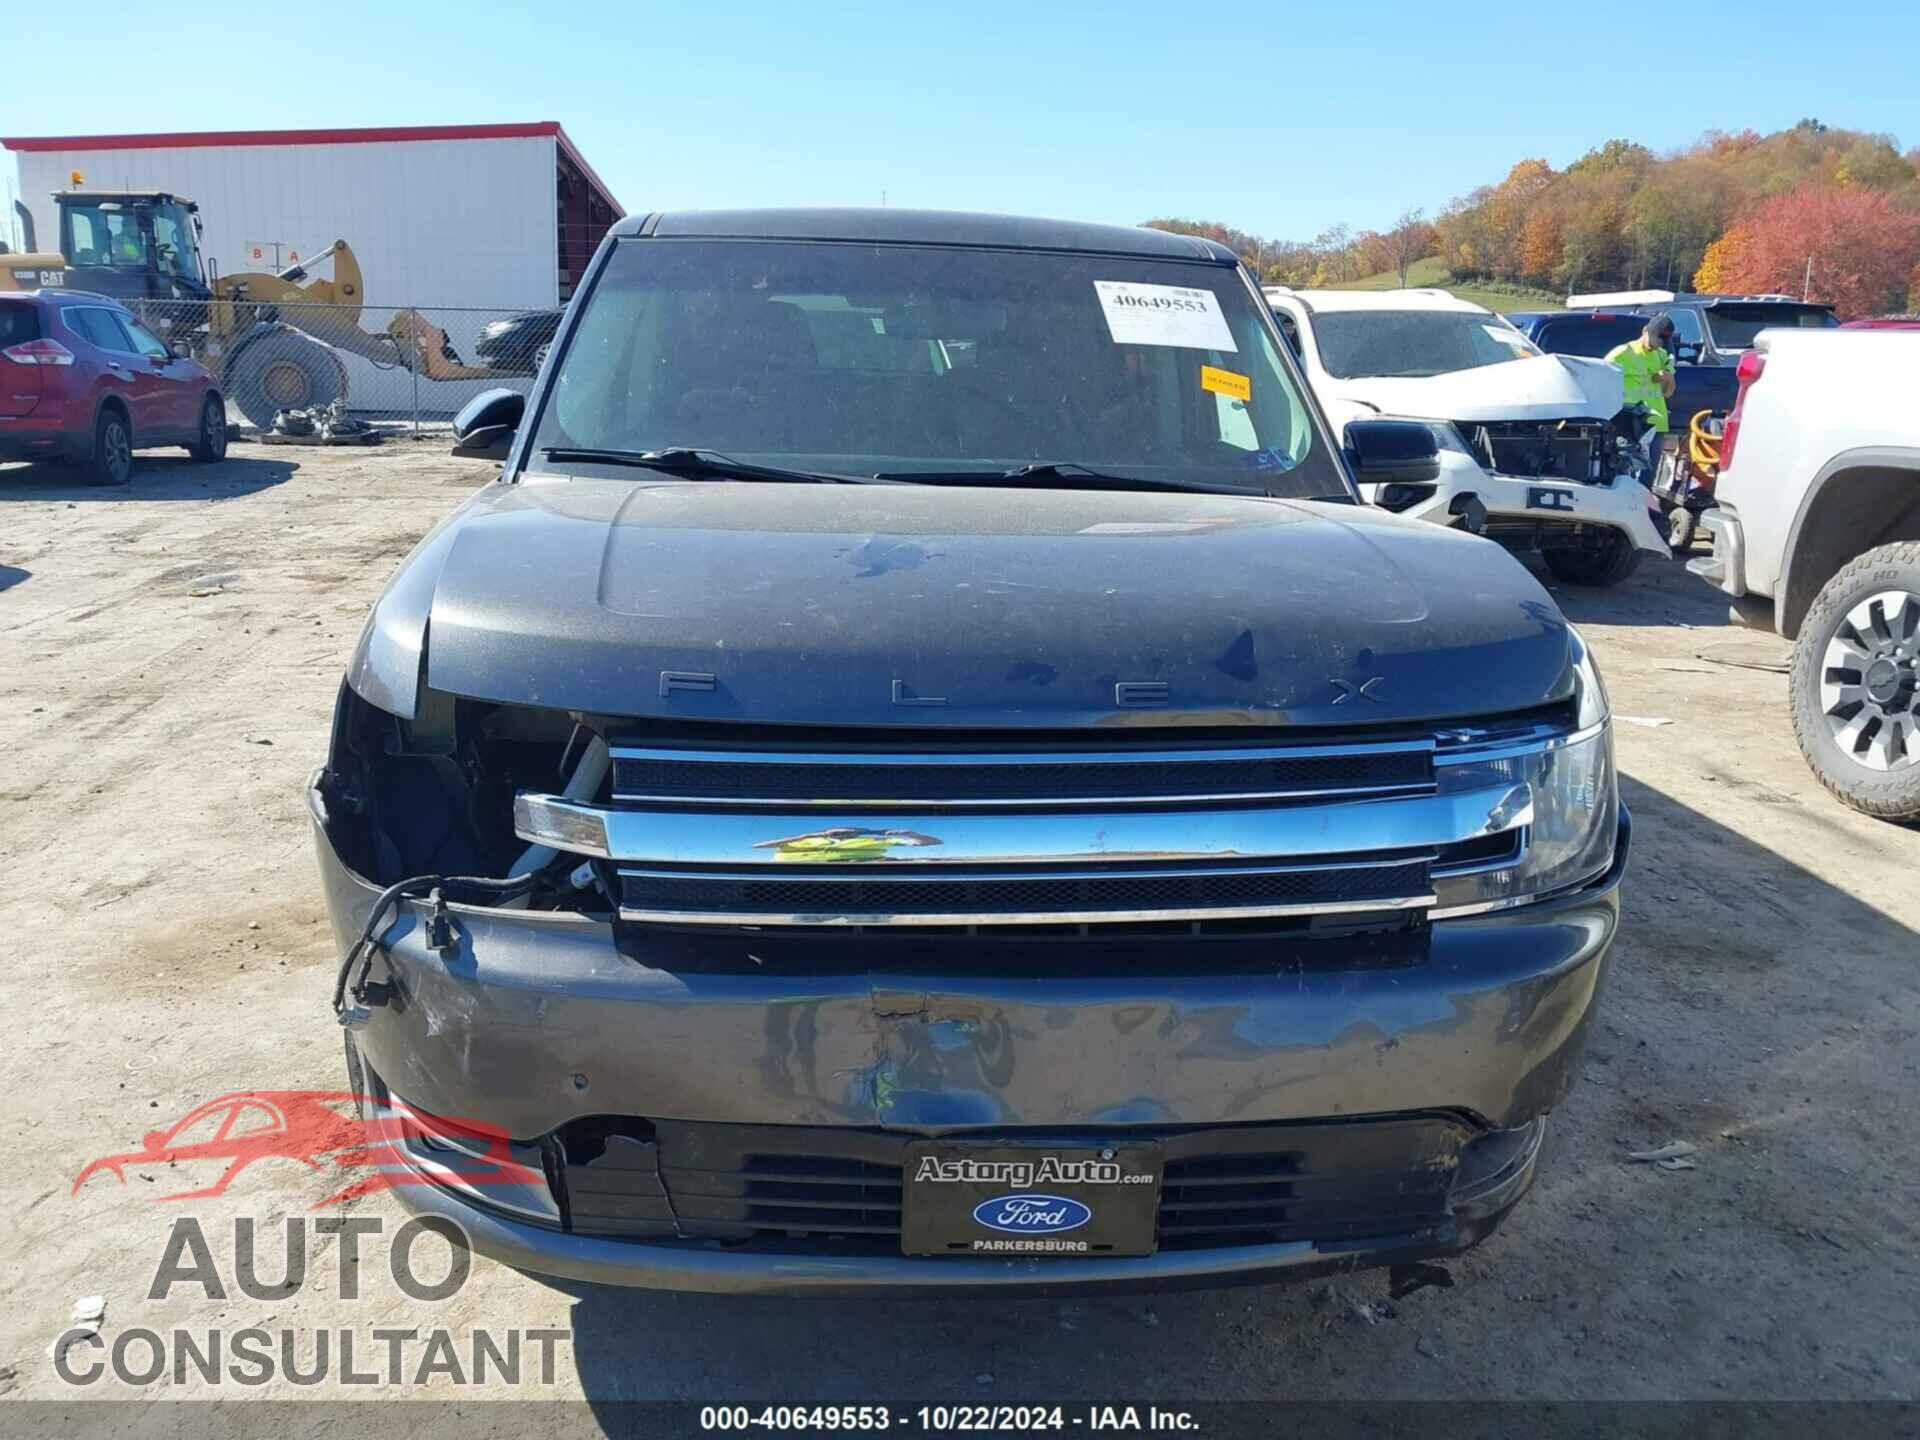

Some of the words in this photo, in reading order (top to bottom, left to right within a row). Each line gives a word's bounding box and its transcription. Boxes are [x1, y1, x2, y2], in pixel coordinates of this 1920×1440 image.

[253, 248, 262, 259] B
[290, 250, 299, 262] A
[40, 271, 65, 286] CAT
[1113, 294, 1208, 313] 40649553
[997, 1199, 1068, 1226] Ford
[973, 1240, 1088, 1252] PARKERSBURG
